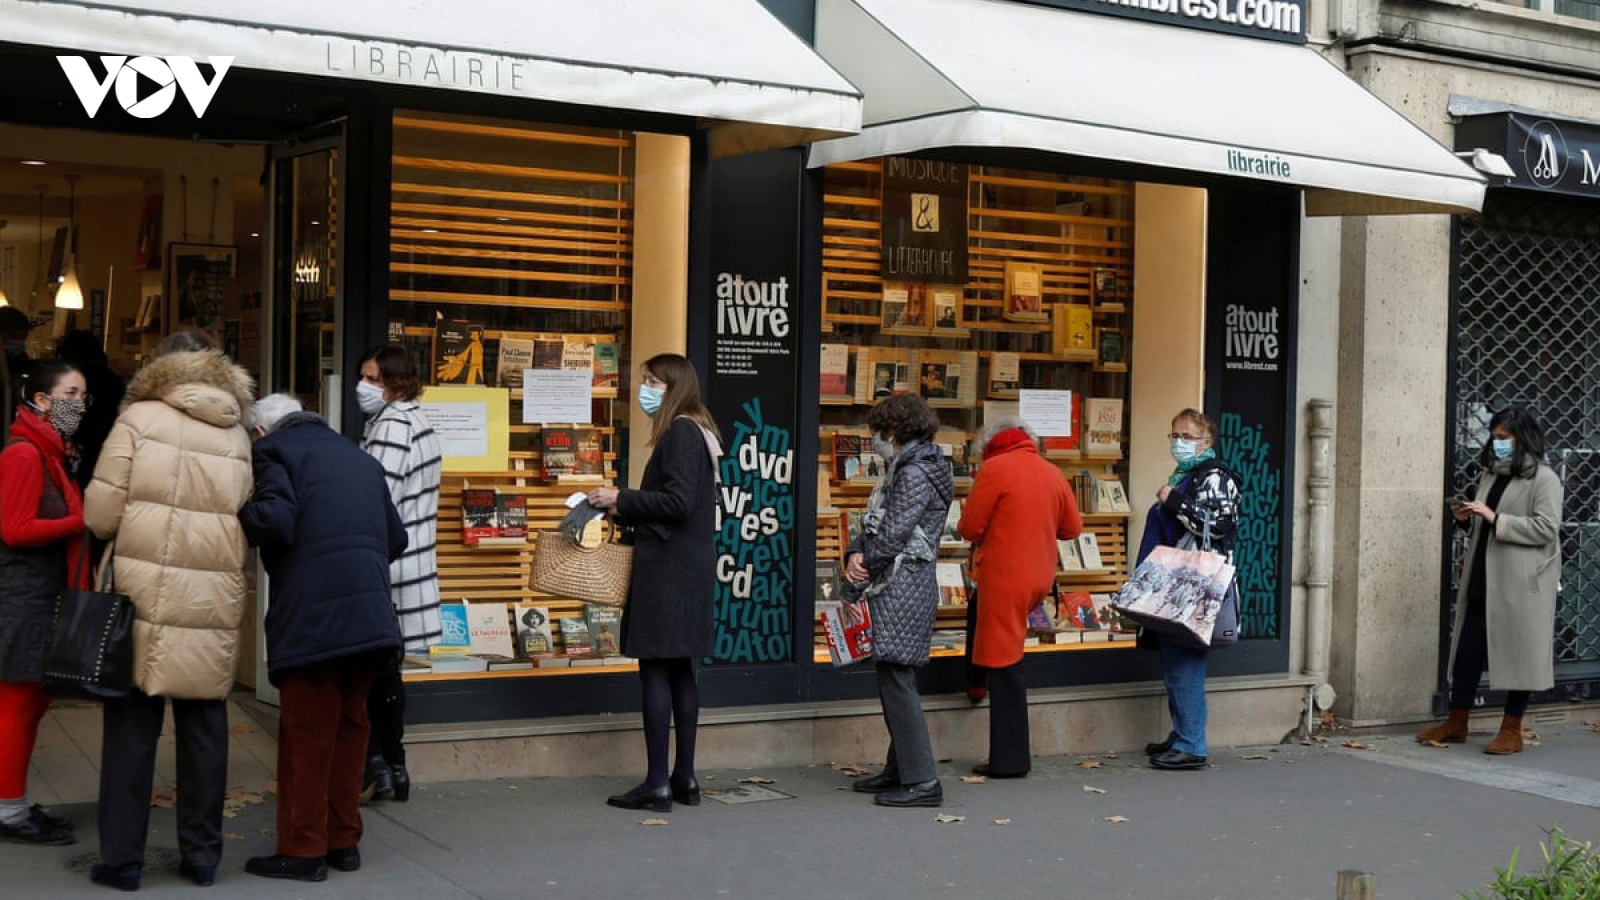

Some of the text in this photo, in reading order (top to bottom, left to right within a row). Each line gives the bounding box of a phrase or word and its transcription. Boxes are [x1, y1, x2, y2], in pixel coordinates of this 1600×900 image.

[327, 42, 524, 91] LIBRAIRIE
[1228, 150, 1290, 178] librairie
[716, 272, 789, 308] atout
[717, 299, 789, 337] livre
[1226, 304, 1279, 333] atout
[1226, 326, 1279, 359] livre
[739, 435, 793, 484] dvd
